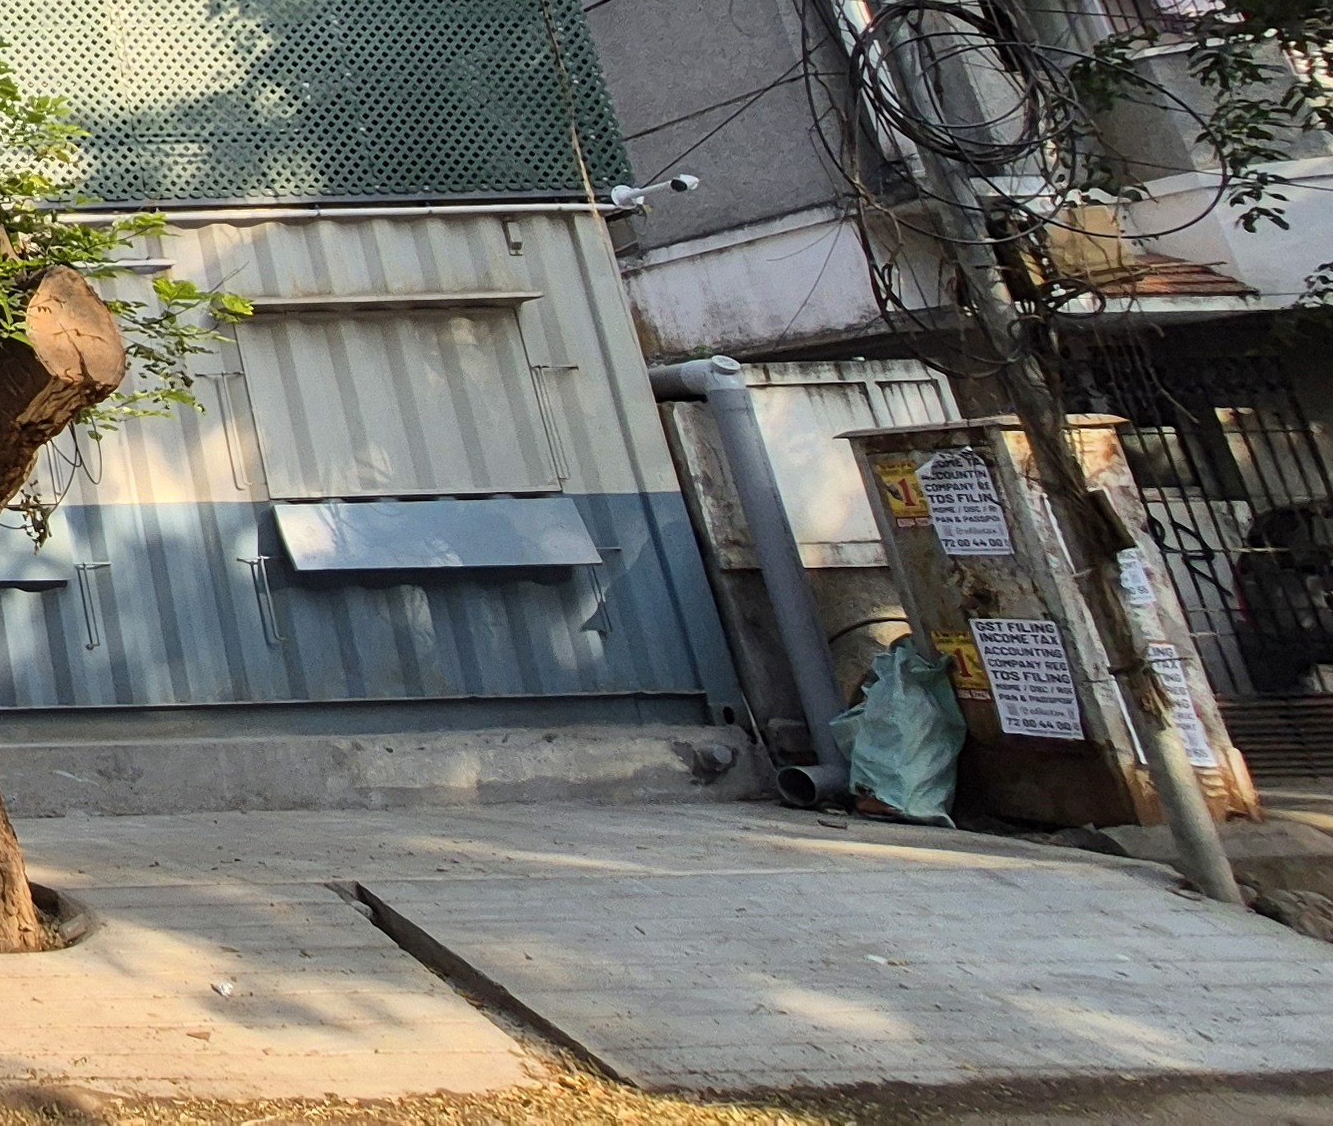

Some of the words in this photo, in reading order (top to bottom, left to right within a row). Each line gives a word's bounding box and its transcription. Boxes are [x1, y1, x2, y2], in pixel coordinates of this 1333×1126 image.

[928, 493, 955, 504] TDS
[957, 493, 993, 503] FILIN
[975, 622, 1004, 632] GST
[1008, 622, 1055, 634] FILING
[979, 633, 1028, 644] INCOME
[1031, 634, 1059, 646] TAX
[984, 646, 1063, 658] ACCOUNTING
[988, 658, 1041, 669] COMPANY
[991, 669, 1020, 681] TDS
[1023, 671, 1071, 684] FILING
